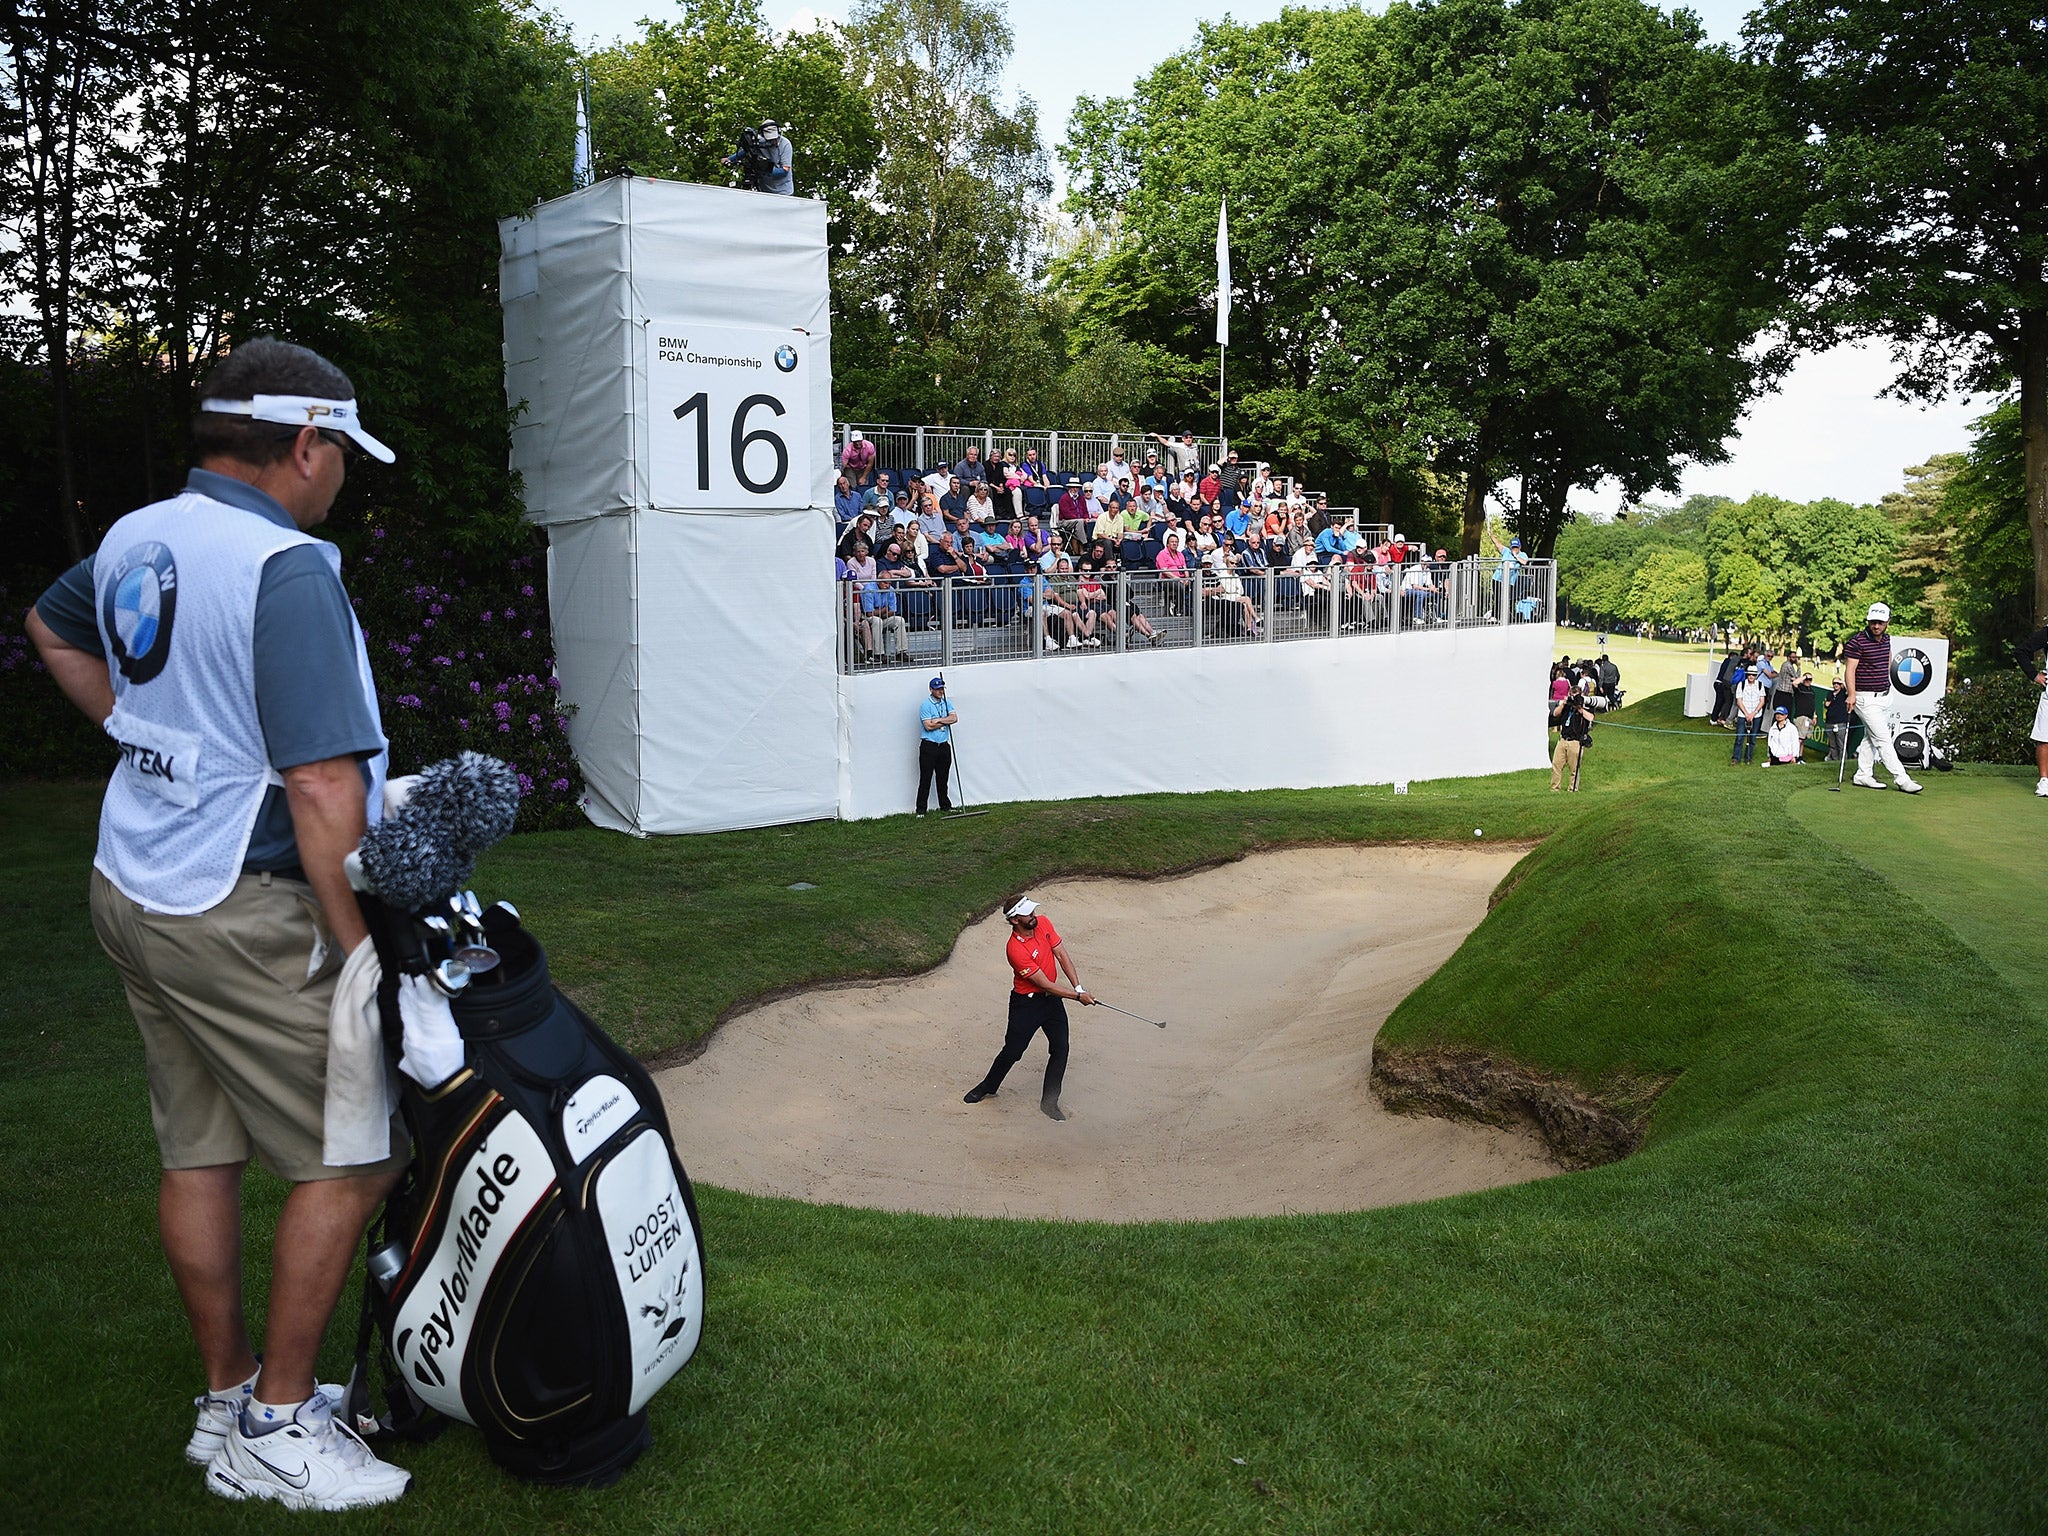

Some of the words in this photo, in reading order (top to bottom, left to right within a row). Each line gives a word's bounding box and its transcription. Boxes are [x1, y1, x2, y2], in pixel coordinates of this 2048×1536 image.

[658, 337, 689, 349] BMW
[658, 351, 684, 362] PGA
[686, 352, 762, 369] Championship
[672, 392, 789, 494] 16
[113, 544, 176, 592] BMW
[1894, 649, 1930, 666] BMW
[576, 1095, 620, 1134] TaylorMade
[624, 1193, 675, 1257] JOOST
[396, 1153, 520, 1387] TaylorMade
[628, 1218, 681, 1283] LUITEN
